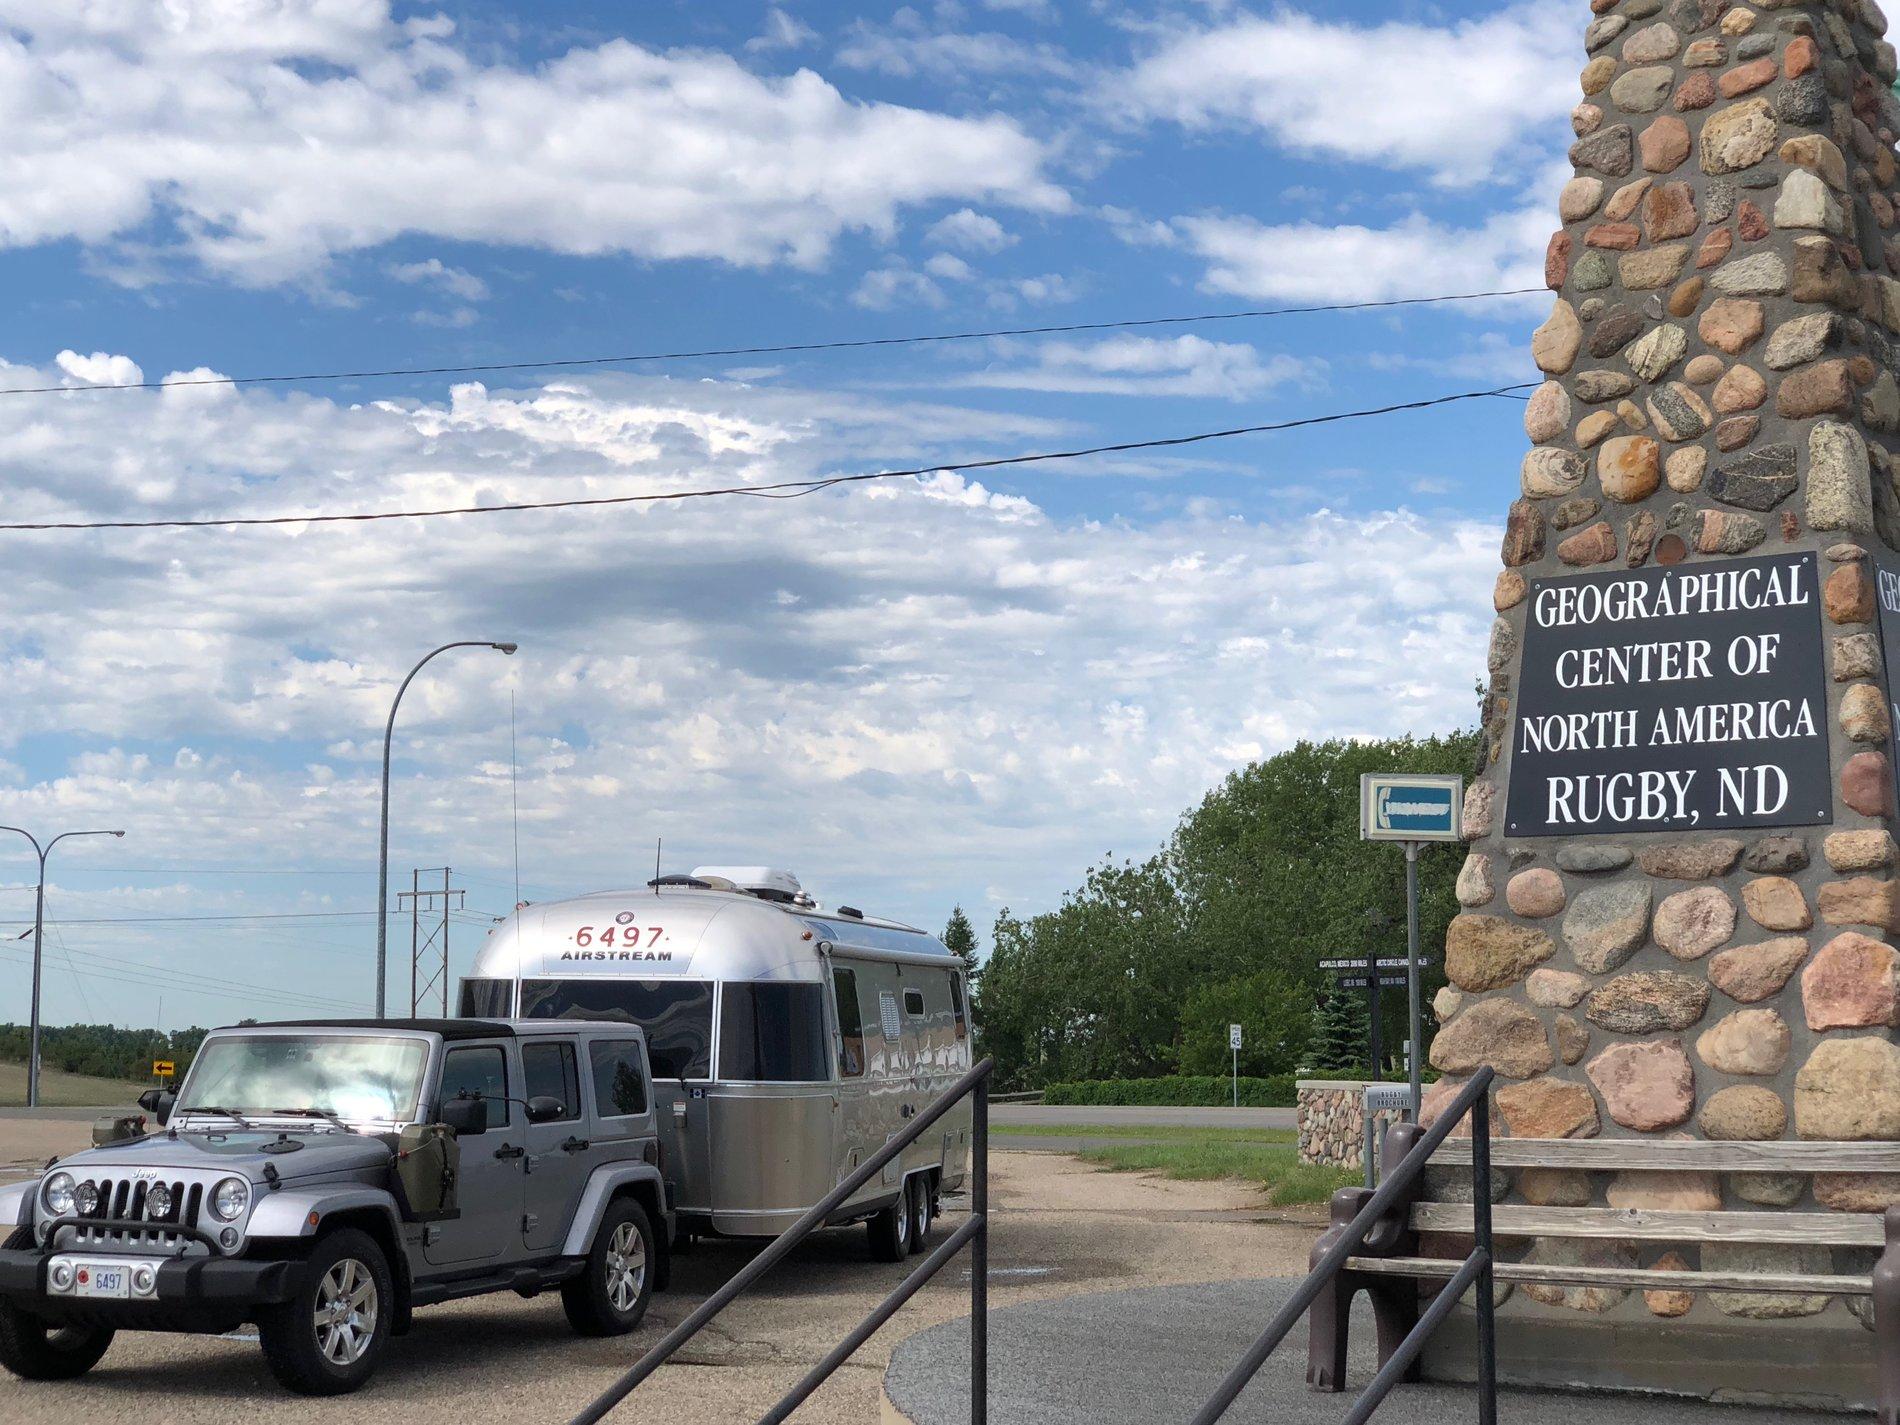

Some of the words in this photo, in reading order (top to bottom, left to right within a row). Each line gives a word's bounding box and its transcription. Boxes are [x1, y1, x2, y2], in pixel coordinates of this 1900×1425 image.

[1535, 564, 1809, 627] GEOGRAPHICAL
[1555, 639, 1714, 688] CENTER
[1727, 633, 1780, 676] OF
[1520, 709, 1639, 753] NORTH
[1647, 697, 1818, 746] AMERICA
[1545, 769, 1700, 826] RUGBY,
[1715, 763, 1789, 817] ND
[560, 950, 673, 961] AIRSTREAM
[1231, 1036, 1241, 1047] 45
[1377, 1099, 1408, 1107] BROCHURE
[131, 1168, 158, 1181] Jeep
[96, 1273, 122, 1291] 6497
